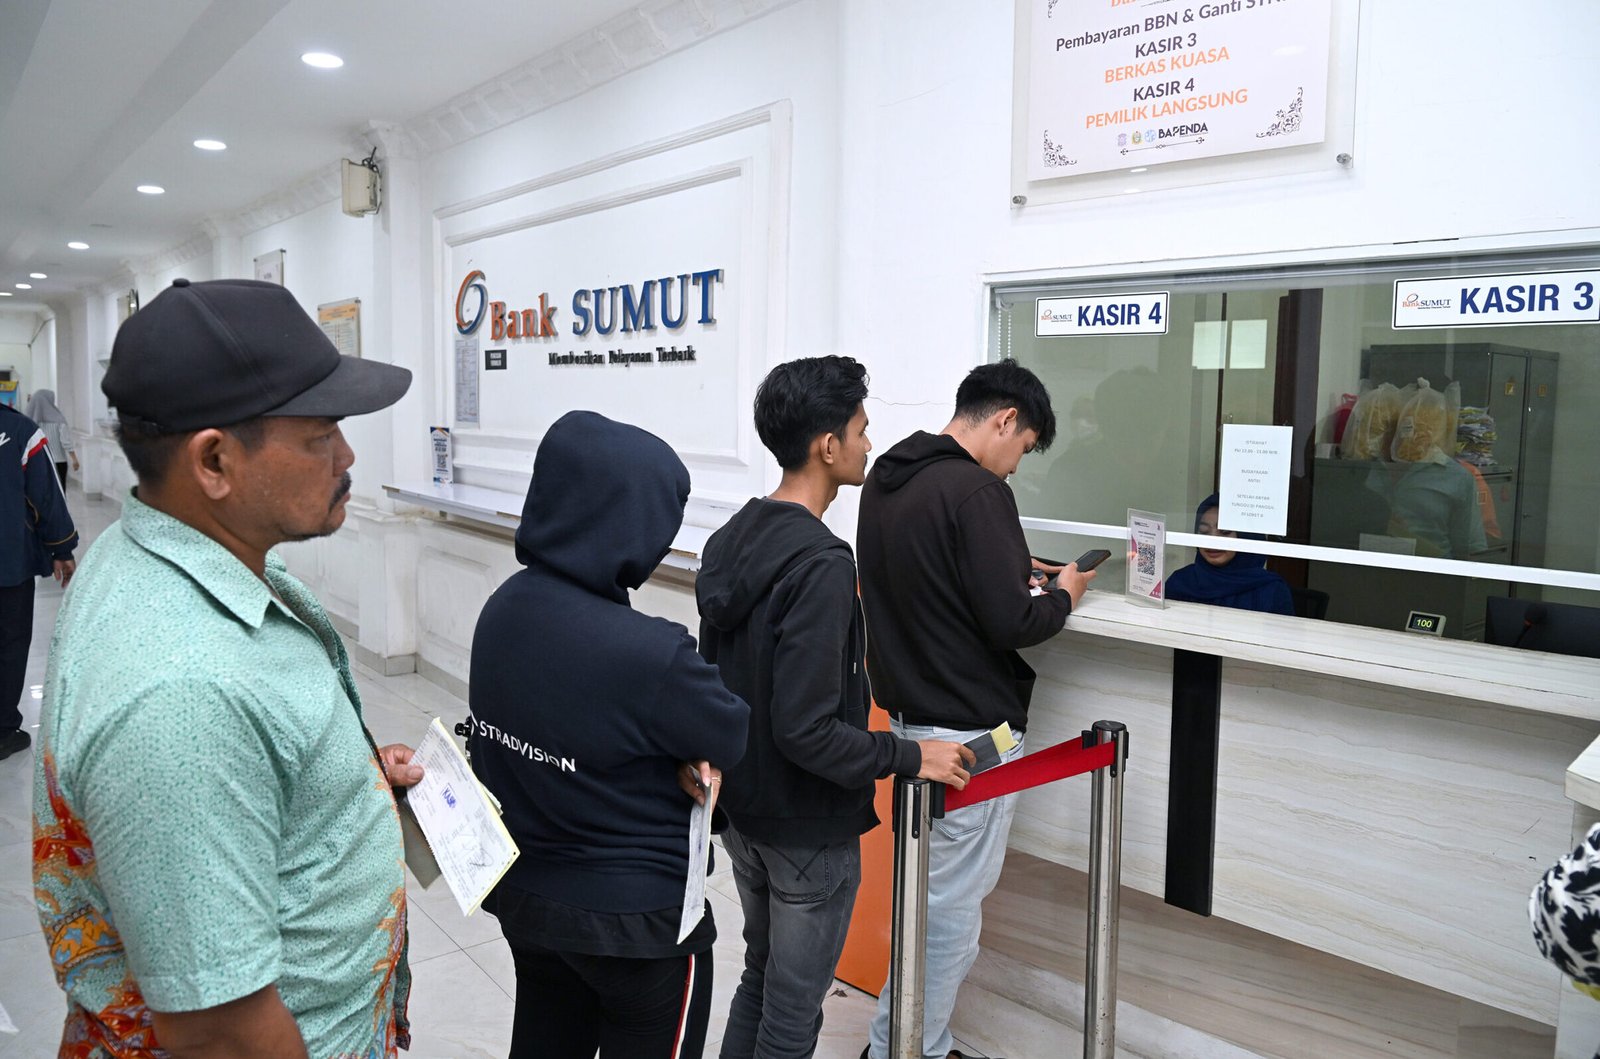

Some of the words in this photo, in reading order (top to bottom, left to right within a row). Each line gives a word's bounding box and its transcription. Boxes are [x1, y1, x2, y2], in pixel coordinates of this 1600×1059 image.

[1056, 23, 1140, 51] Pembayaran
[1144, 11, 1178, 32] BBN
[1182, 8, 1194, 23] &
[1198, 0, 1241, 19] Ganti
[1135, 36, 1183, 58] KASIR
[1187, 32, 1197, 47] 3
[1104, 59, 1166, 84] BERKAS
[1170, 46, 1230, 71] KUASA
[1133, 80, 1181, 102] KASIR
[1184, 77, 1195, 92] 4
[1085, 106, 1148, 129] PEMILIK
[1152, 88, 1248, 118] LANGSUNG
[1158, 122, 1209, 139] BAPENDA
[488, 292, 558, 341] Bank
[572, 268, 724, 336] SUMUT
[1420, 299, 1451, 307] SUMUT
[1460, 284, 1560, 315] KASIR
[1573, 281, 1594, 311] 3
[1077, 303, 1141, 327] KASIR
[1148, 302, 1162, 325] 4
[1416, 618, 1433, 628] 100
[480, 720, 576, 773] STRADVISION
